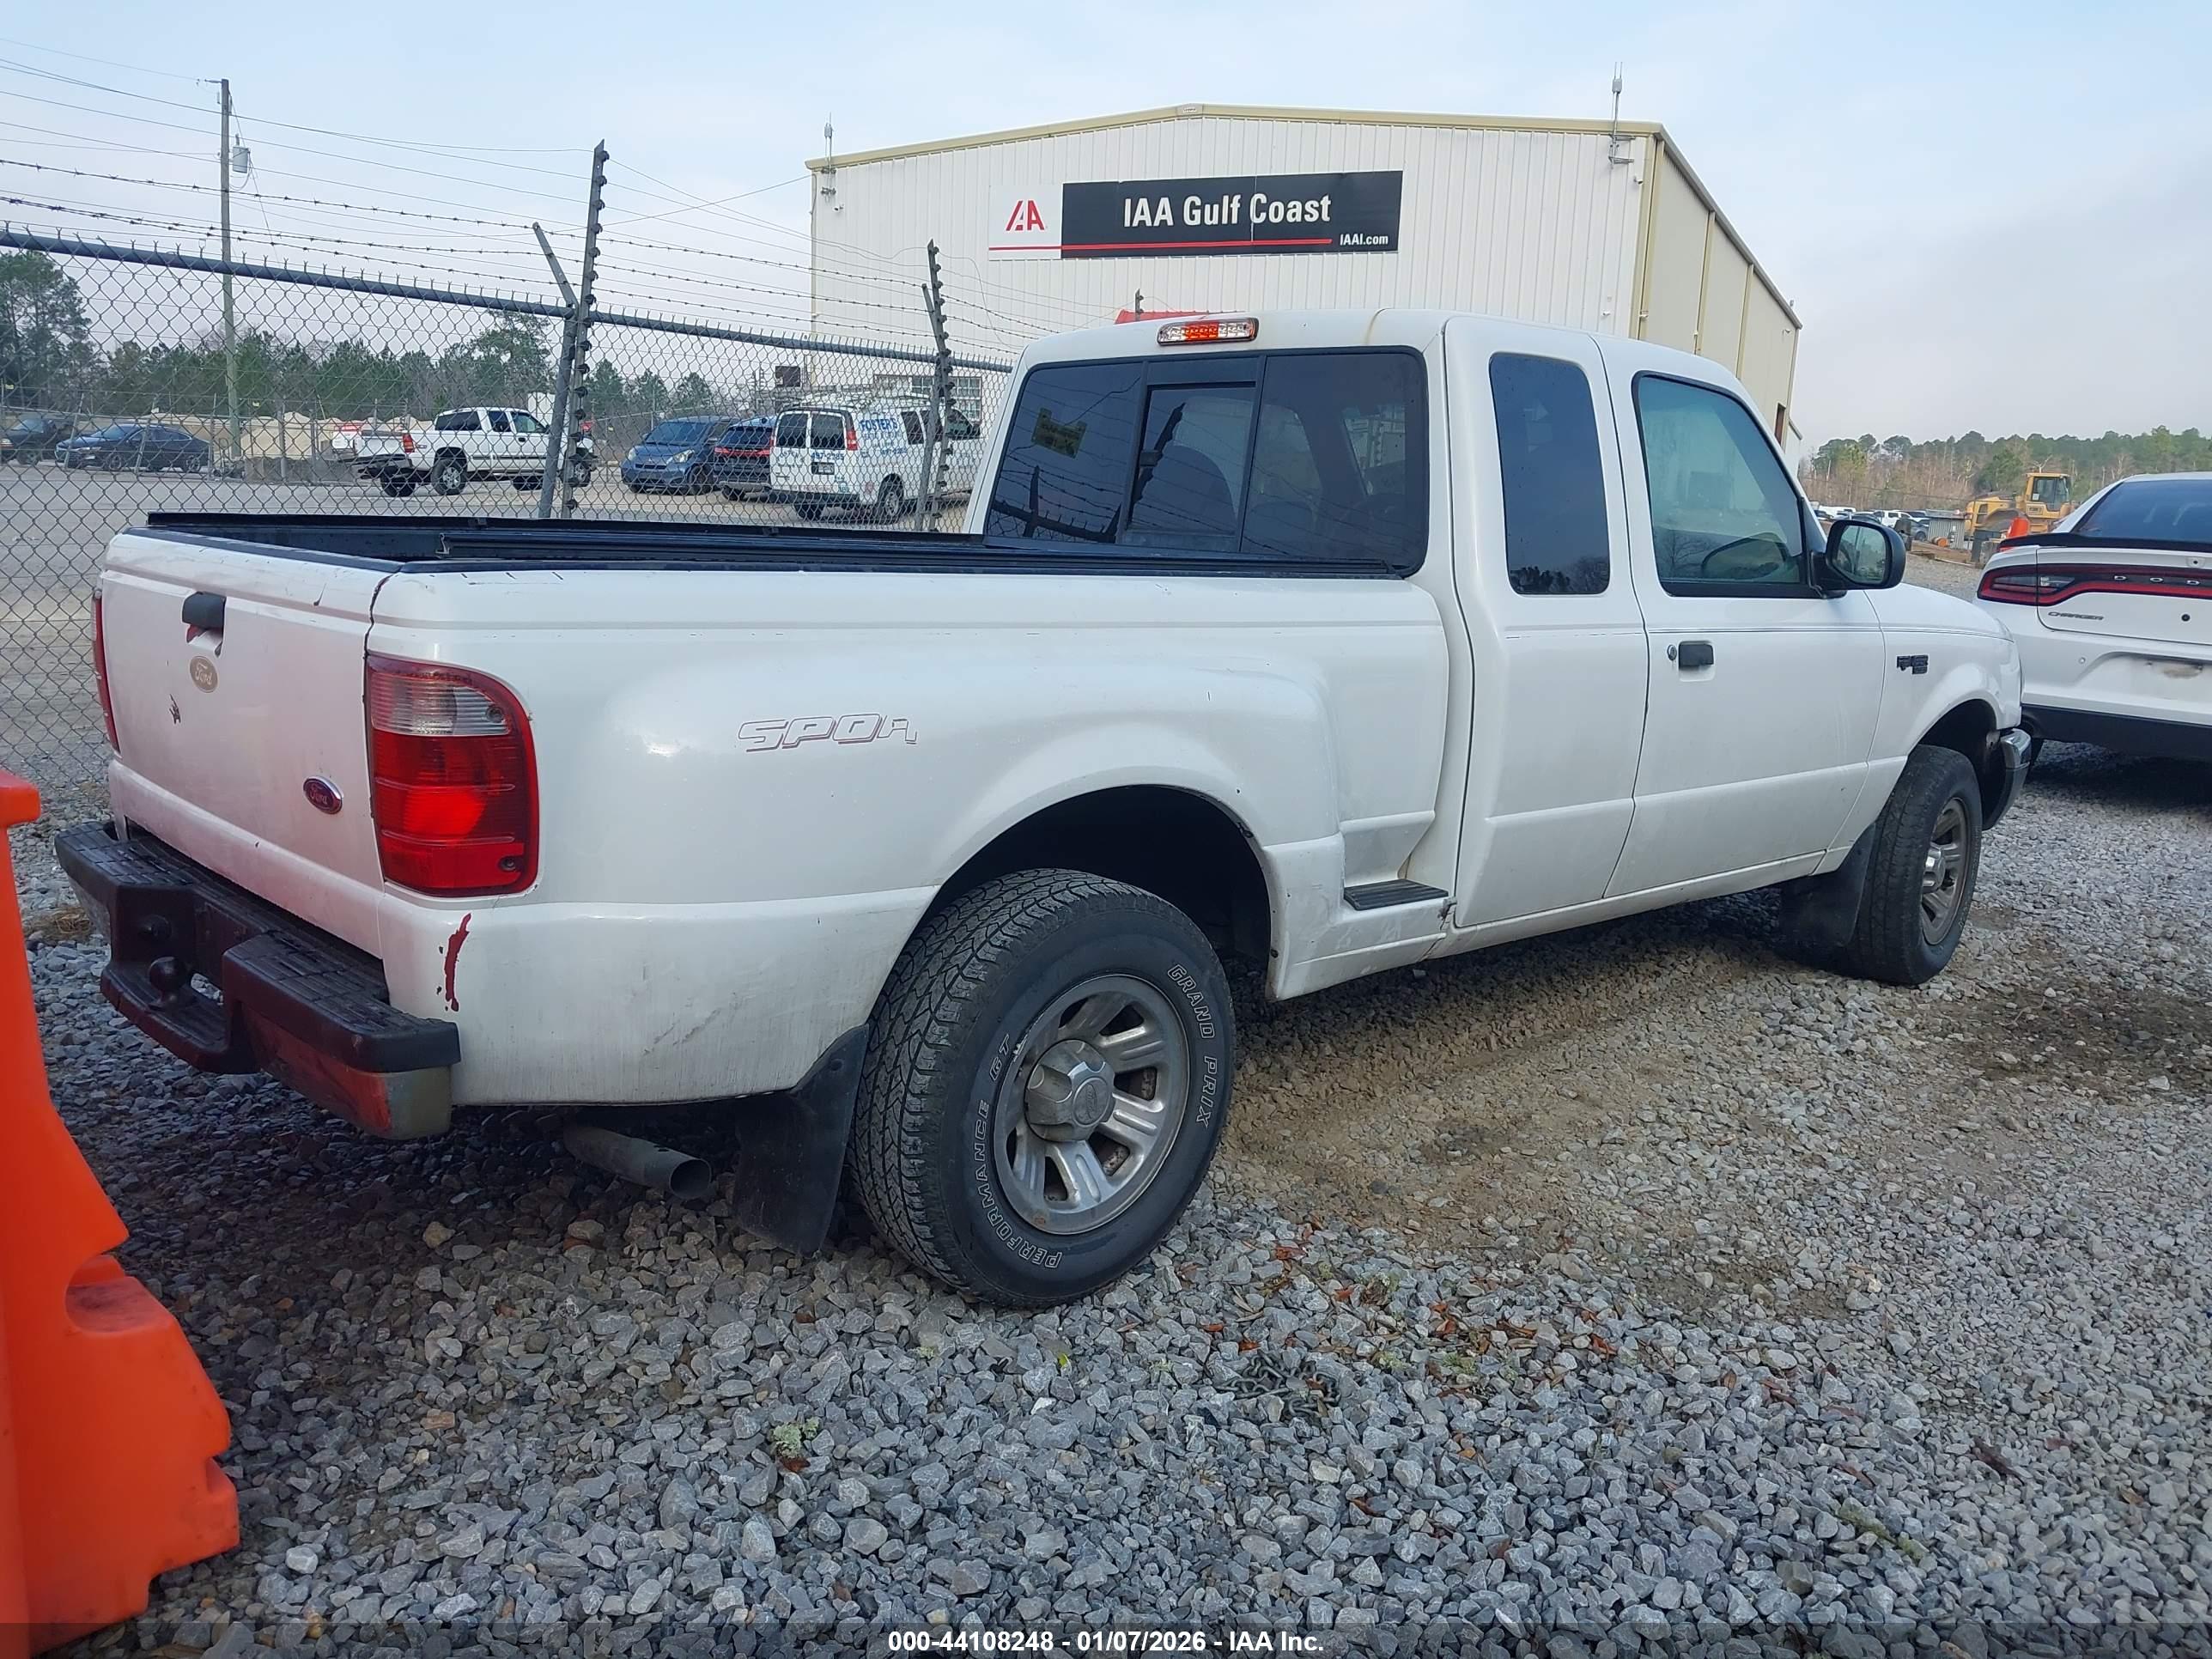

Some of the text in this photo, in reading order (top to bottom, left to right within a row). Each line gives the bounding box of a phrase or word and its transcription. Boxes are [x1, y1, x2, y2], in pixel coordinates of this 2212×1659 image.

[1123, 193, 1331, 228] IAA Gulf Coast
[1340, 233, 1389, 246] IAAI.com
[2048, 611, 2104, 621] CHARGER
[1168, 964, 1218, 1133] GRAND PRIX
[974, 1033, 1063, 1268] PERFORMANCE GT
